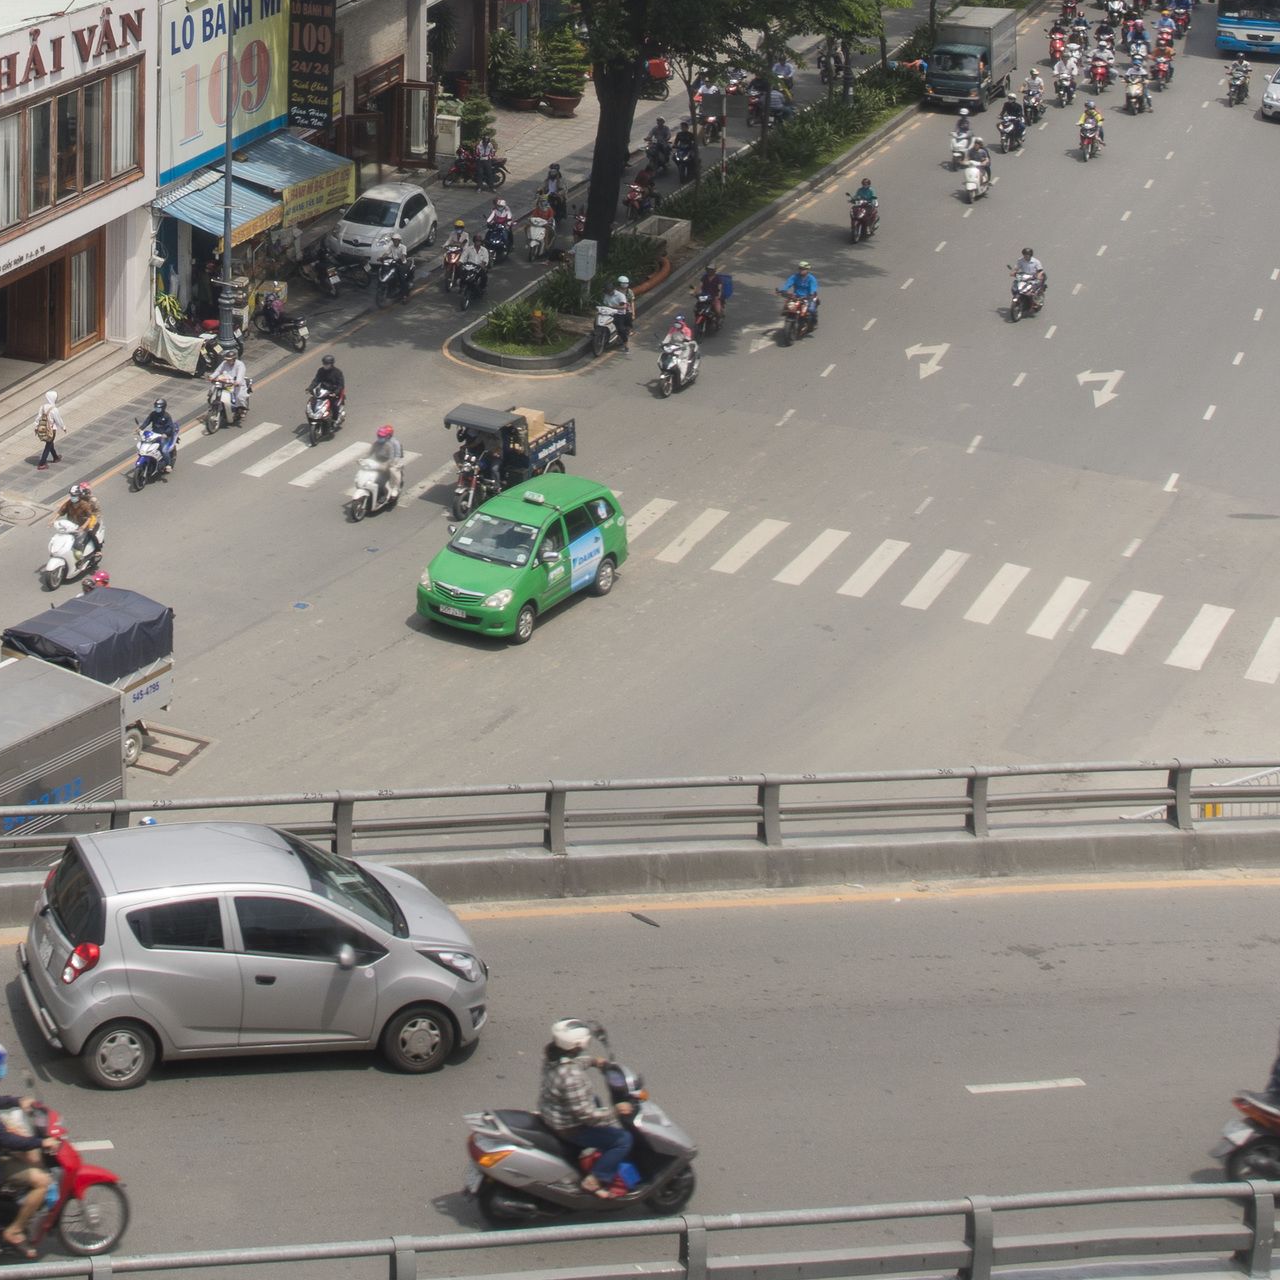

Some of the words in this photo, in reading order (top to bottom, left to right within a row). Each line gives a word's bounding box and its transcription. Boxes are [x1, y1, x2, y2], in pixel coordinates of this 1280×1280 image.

[72, 6, 146, 63] VÂN
[171, 6, 195, 56] LÒ
[291, 22, 332, 55] 109
[179, 39, 272, 147] 109
